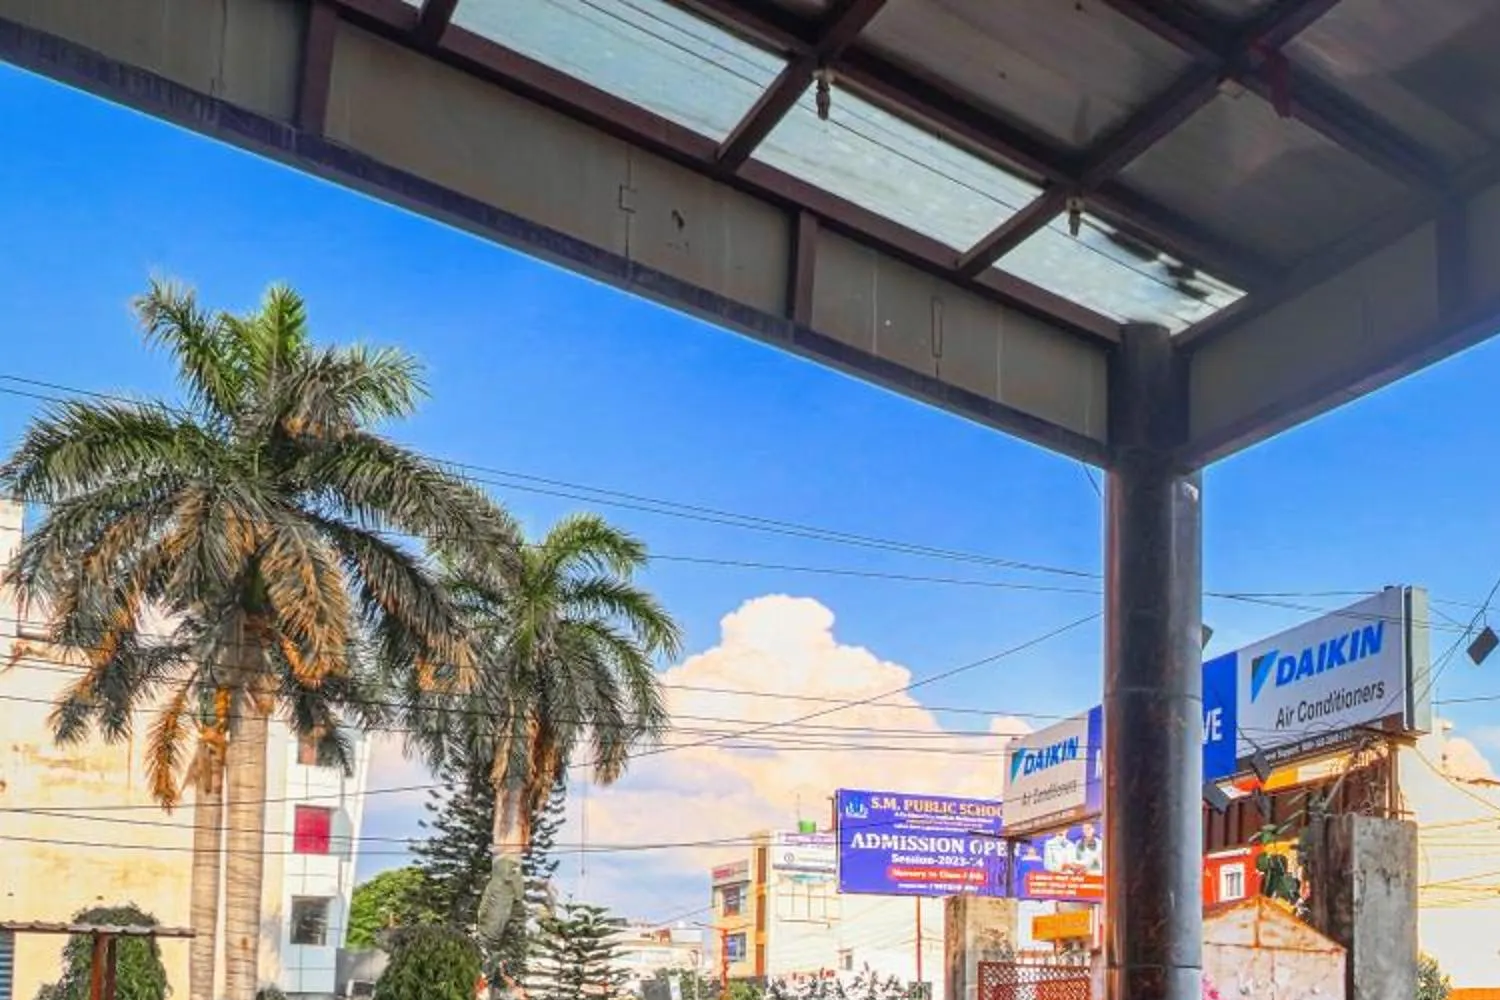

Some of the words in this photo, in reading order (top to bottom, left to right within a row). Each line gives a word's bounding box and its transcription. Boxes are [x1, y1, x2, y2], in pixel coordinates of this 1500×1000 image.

[1275, 620, 1384, 688] DAIKIN
[1275, 706, 1295, 730] Air
[1297, 681, 1385, 724] Conditioners
[1023, 735, 1079, 777] DAIKIN
[871, 796, 901, 812] S.M.
[904, 798, 957, 813] PUBLIC
[851, 832, 965, 855] ADMISSION
